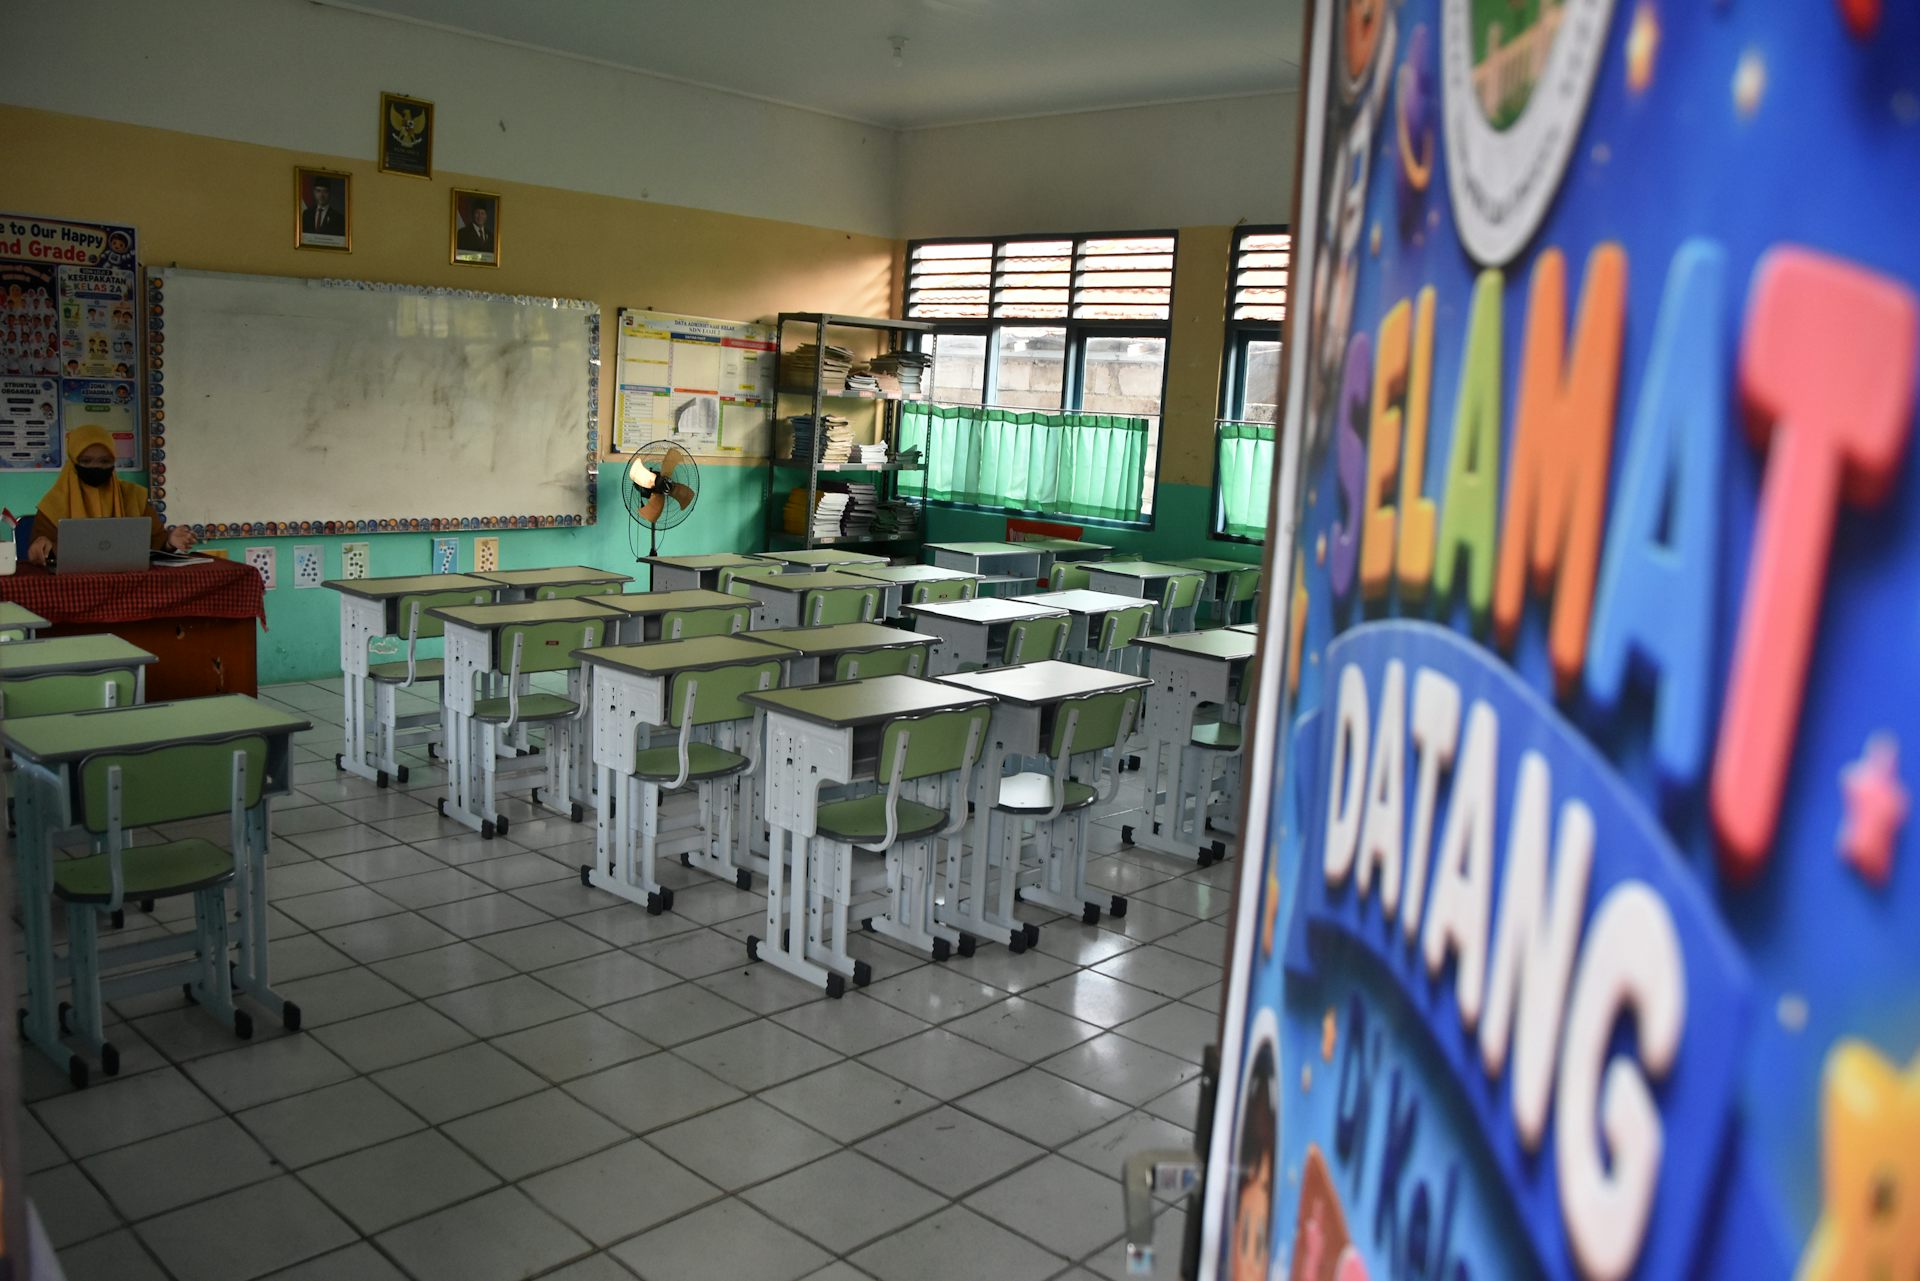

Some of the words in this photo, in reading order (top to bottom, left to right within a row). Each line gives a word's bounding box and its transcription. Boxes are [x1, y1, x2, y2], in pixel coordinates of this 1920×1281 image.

[10, 222, 26, 235] to
[31, 224, 57, 239] Our
[61, 227, 103, 249] Happy
[29, 240, 86, 262] Grade
[68, 273, 126, 285] KESEPAKATAN
[74, 282, 107, 292] KELAS
[110, 284, 122, 293] 2A
[1328, 236, 1920, 872] SELAMAT
[1324, 657, 1688, 1281] DATANG
